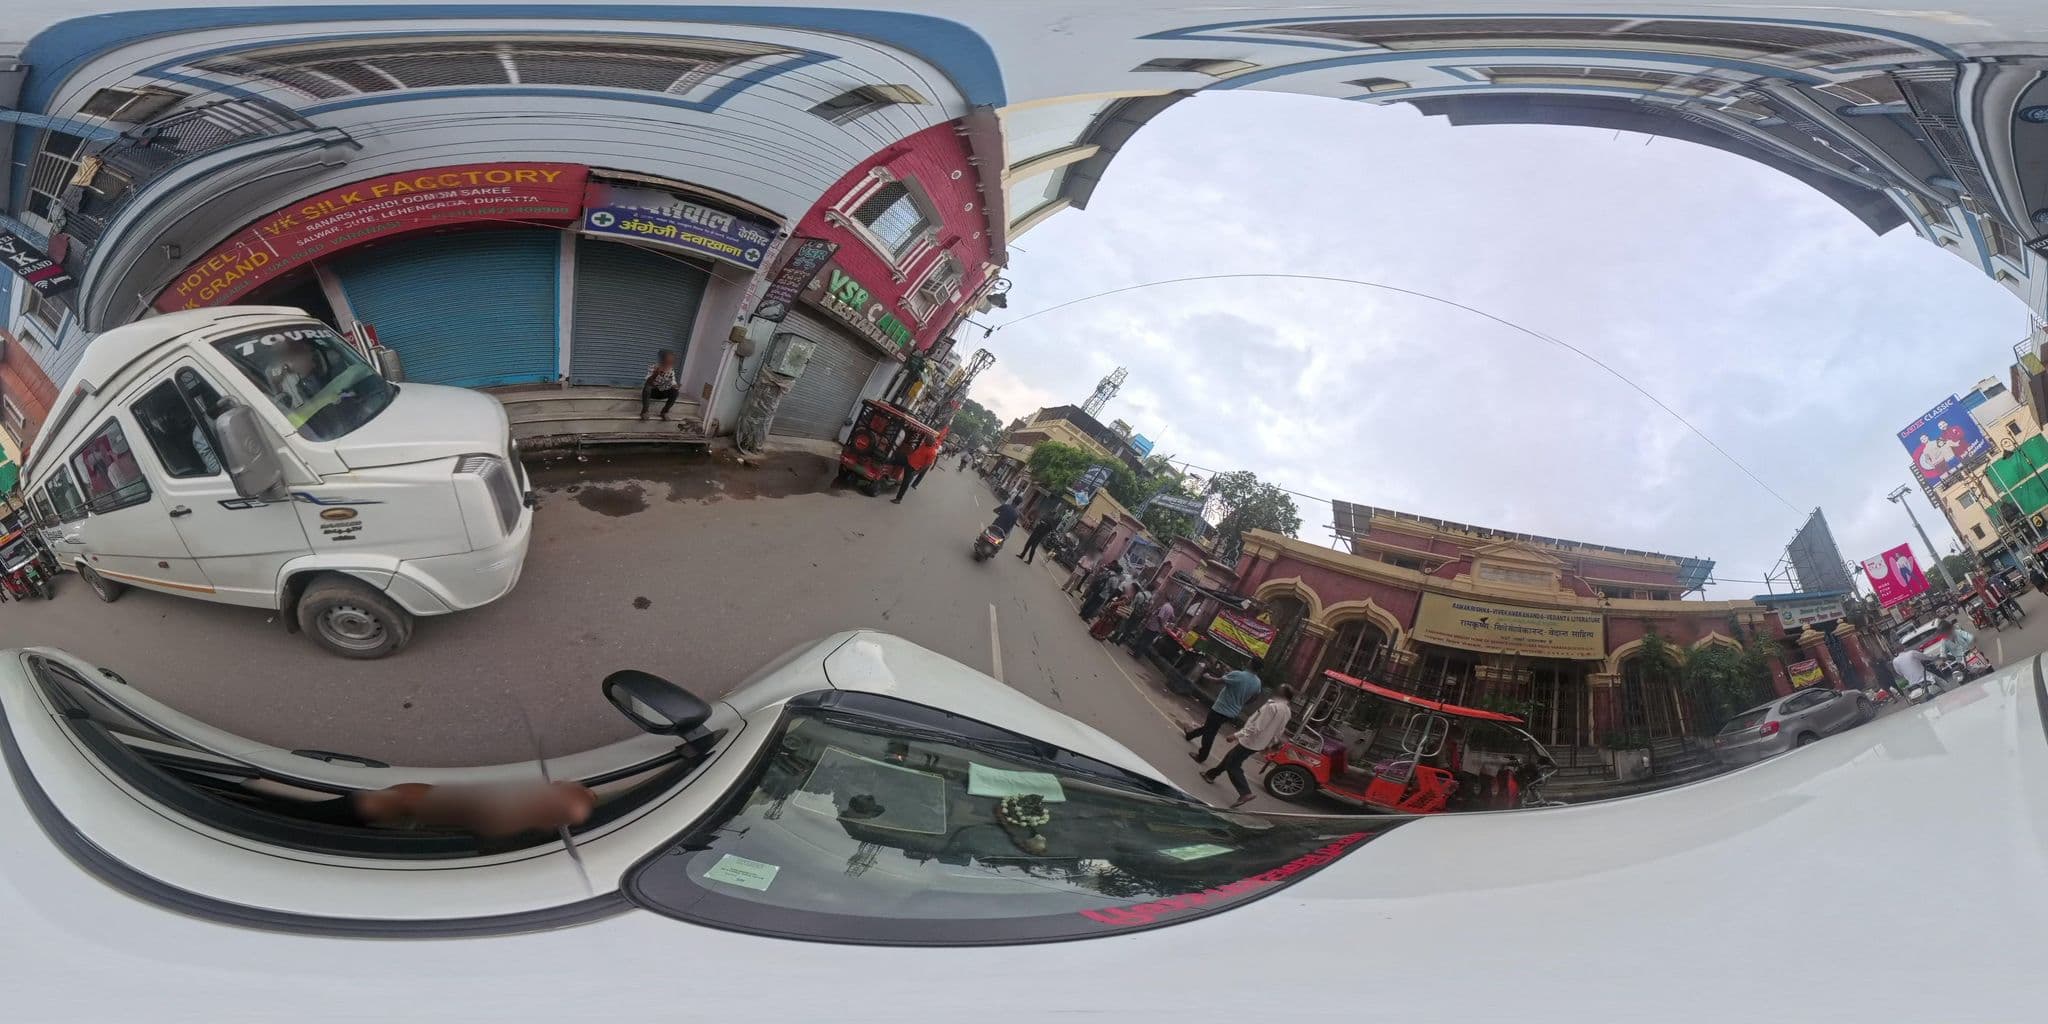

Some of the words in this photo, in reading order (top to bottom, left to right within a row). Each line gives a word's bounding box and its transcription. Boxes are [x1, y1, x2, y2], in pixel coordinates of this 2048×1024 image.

[263, 214, 299, 236] VK
[301, 191, 364, 221] SILK
[680, 230, 742, 257] दवाखाना
[18, 259, 53, 275] GRAND
[176, 252, 237, 297] HOTEL
[199, 251, 270, 301] GRAND
[828, 269, 869, 311] VSR
[1923, 398, 1954, 422] CLASSIC
